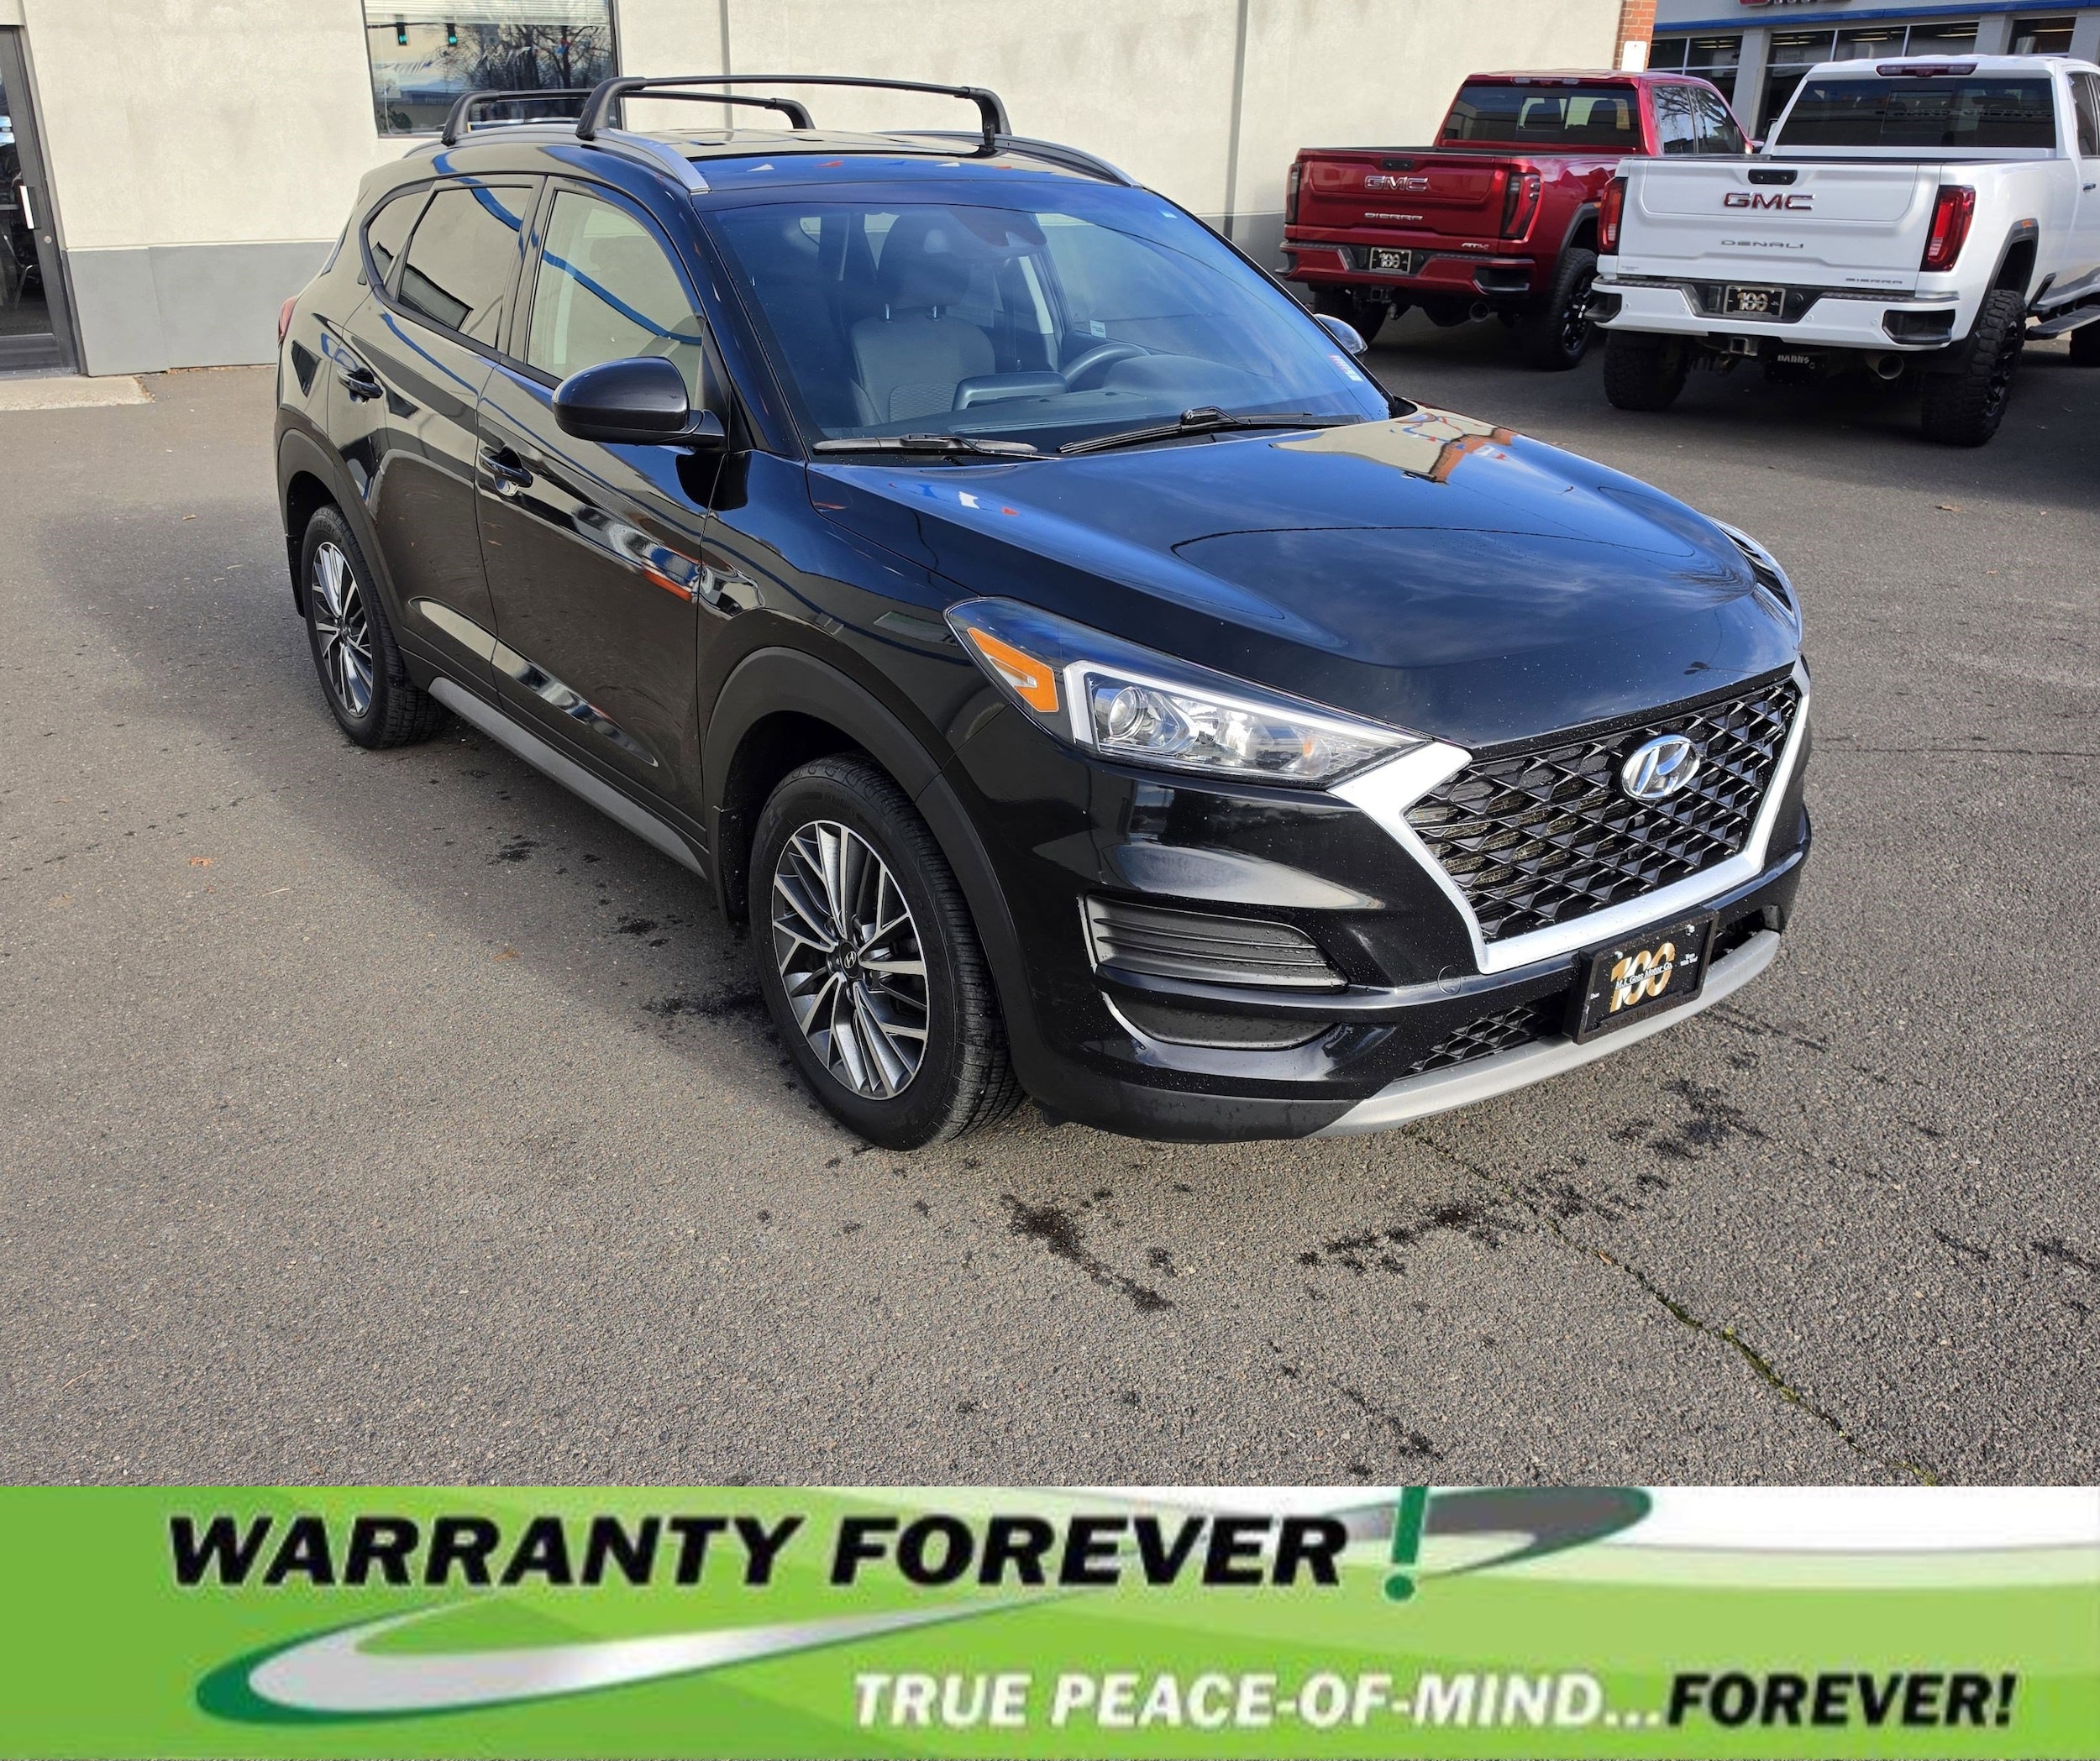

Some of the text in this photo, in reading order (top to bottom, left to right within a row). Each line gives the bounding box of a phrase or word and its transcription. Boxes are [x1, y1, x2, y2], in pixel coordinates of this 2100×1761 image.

[1364, 175, 1428, 191] GMC
[1724, 192, 1816, 211] GMC
[1364, 212, 1424, 221] SIERRA
[1721, 239, 1804, 249] DENALI
[1736, 291, 1769, 312] 100
[1609, 942, 1676, 1013] 100
